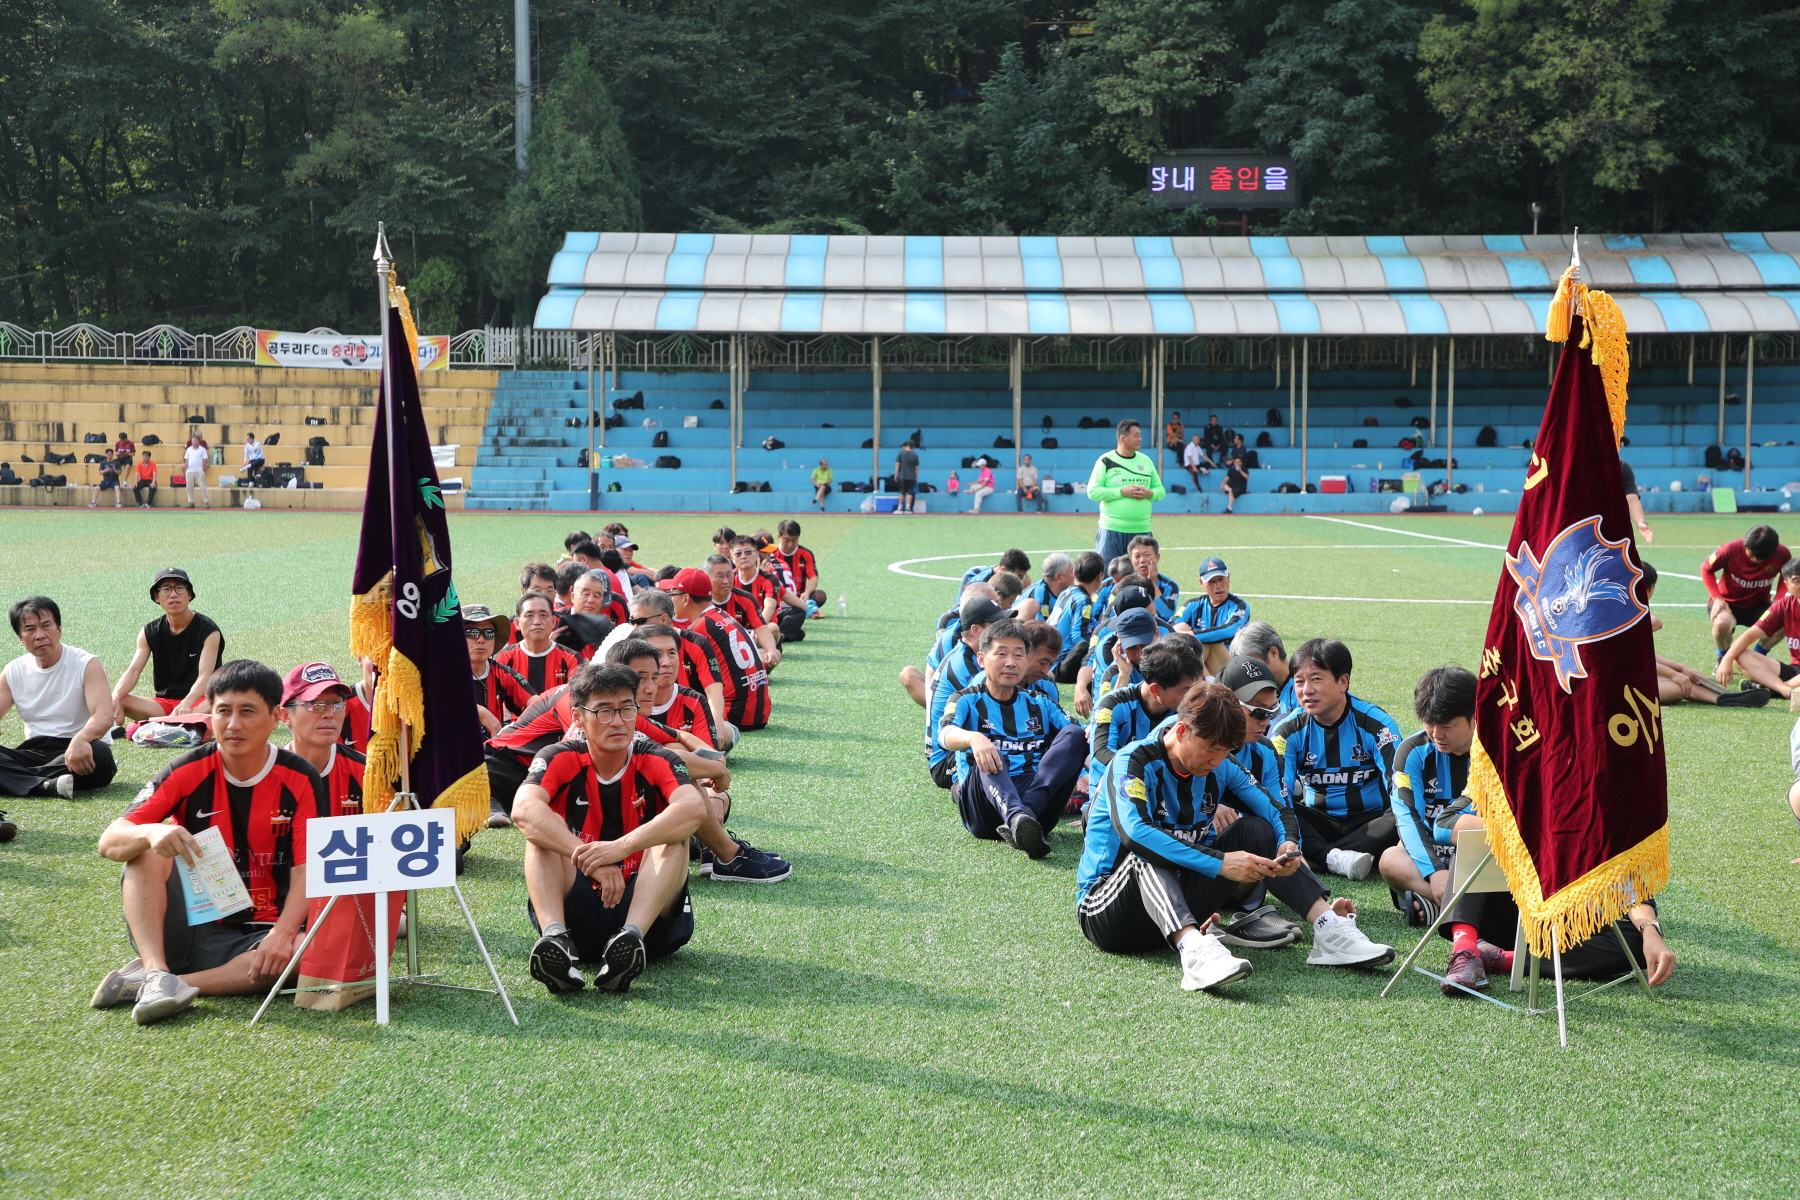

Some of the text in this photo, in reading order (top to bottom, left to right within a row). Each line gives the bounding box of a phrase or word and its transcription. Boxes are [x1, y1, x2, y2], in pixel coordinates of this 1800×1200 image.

[1209, 166, 1288, 191] 출입을
[268, 341, 328, 356] 곰두리FC의
[1524, 602, 1539, 630] GAON
[728, 627, 756, 670] 6
[994, 739, 1024, 751] AON
[318, 821, 444, 884] 삼양
